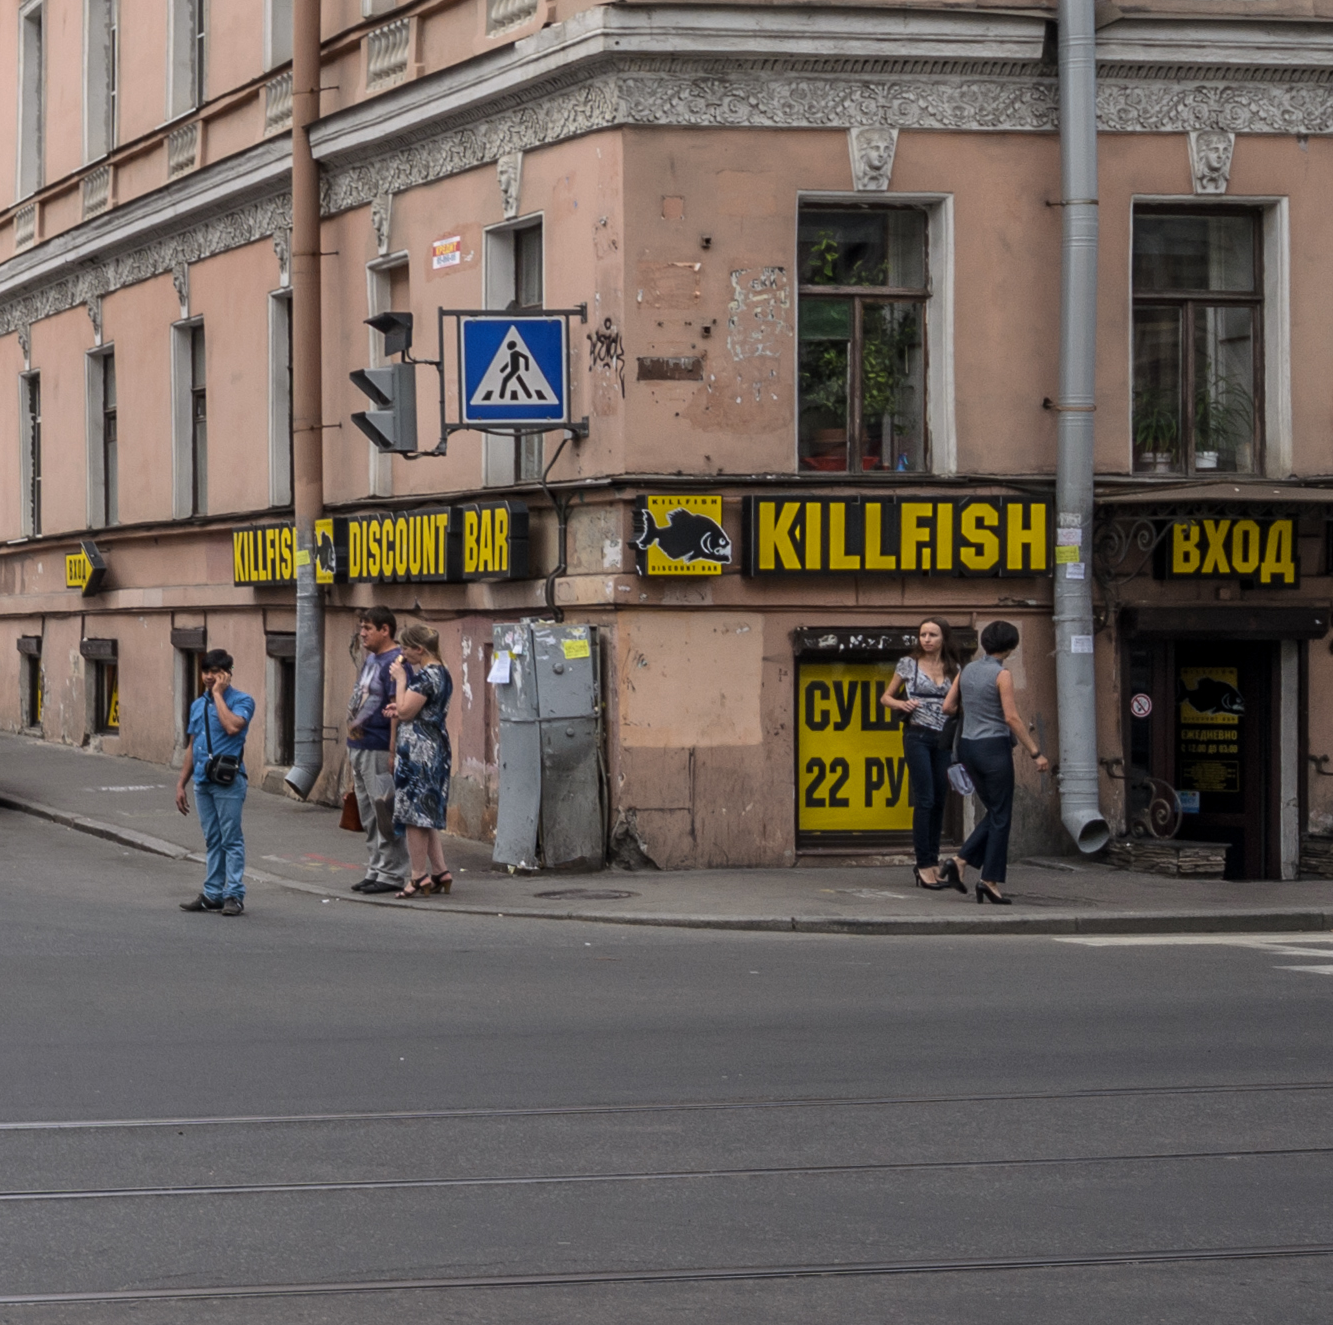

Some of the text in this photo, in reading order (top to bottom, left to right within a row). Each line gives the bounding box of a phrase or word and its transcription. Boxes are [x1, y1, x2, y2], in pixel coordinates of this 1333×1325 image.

[652, 498, 718, 506] KILLFISH
[348, 513, 448, 578] DISCOUNT
[463, 507, 509, 573] BAR
[759, 501, 1046, 570] KILLFISH
[1173, 519, 1295, 584] ВХОД
[805, 680, 902, 731] СУШ
[1181, 729, 1238, 740] ЕЖЕДНЕВНО
[805, 757, 850, 808] 22
